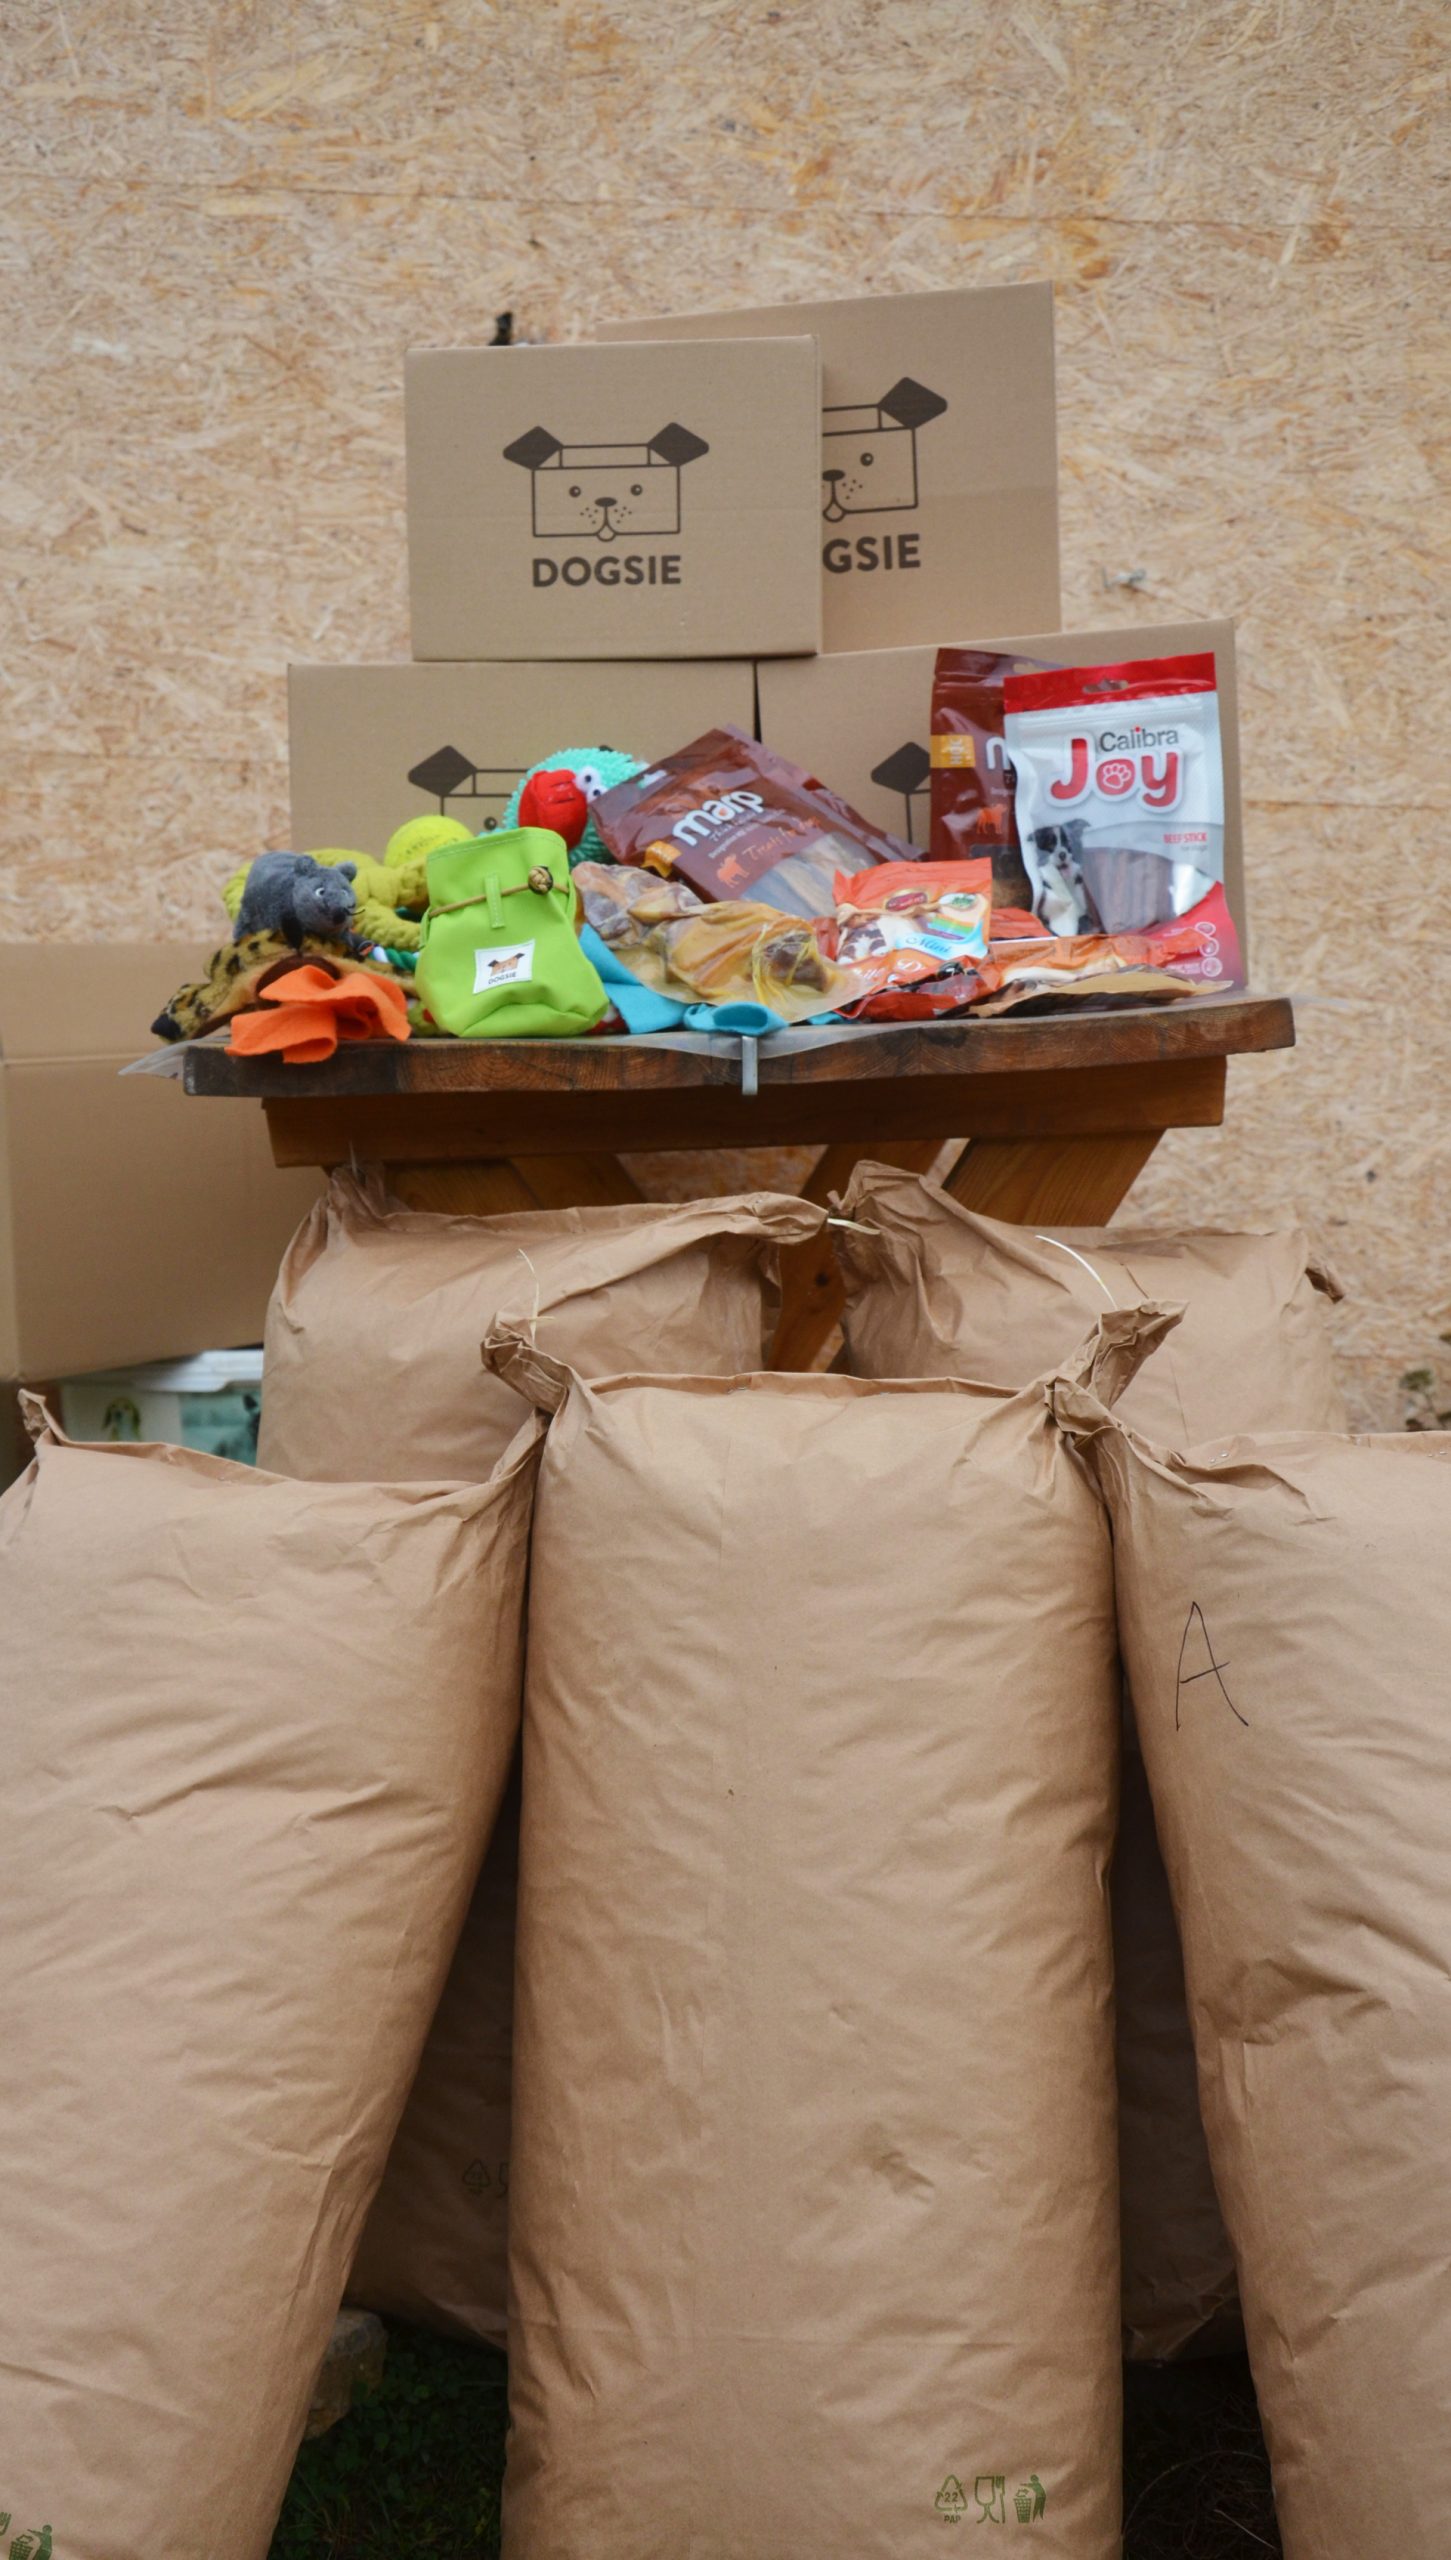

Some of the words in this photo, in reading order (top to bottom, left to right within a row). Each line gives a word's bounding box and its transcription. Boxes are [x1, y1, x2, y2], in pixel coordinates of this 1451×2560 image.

[822, 533, 921, 574] GSIE
[532, 554, 681, 587] DOGSIE
[1100, 727, 1179, 752] Calibra
[1050, 736, 1179, 808] Joy
[672, 790, 764, 847] marp
[488, 971, 517, 985] DOGSIE
[1176, 1601, 1249, 1732] A
[944, 2491, 959, 2503] 22
[944, 2514, 961, 2524] PAP
